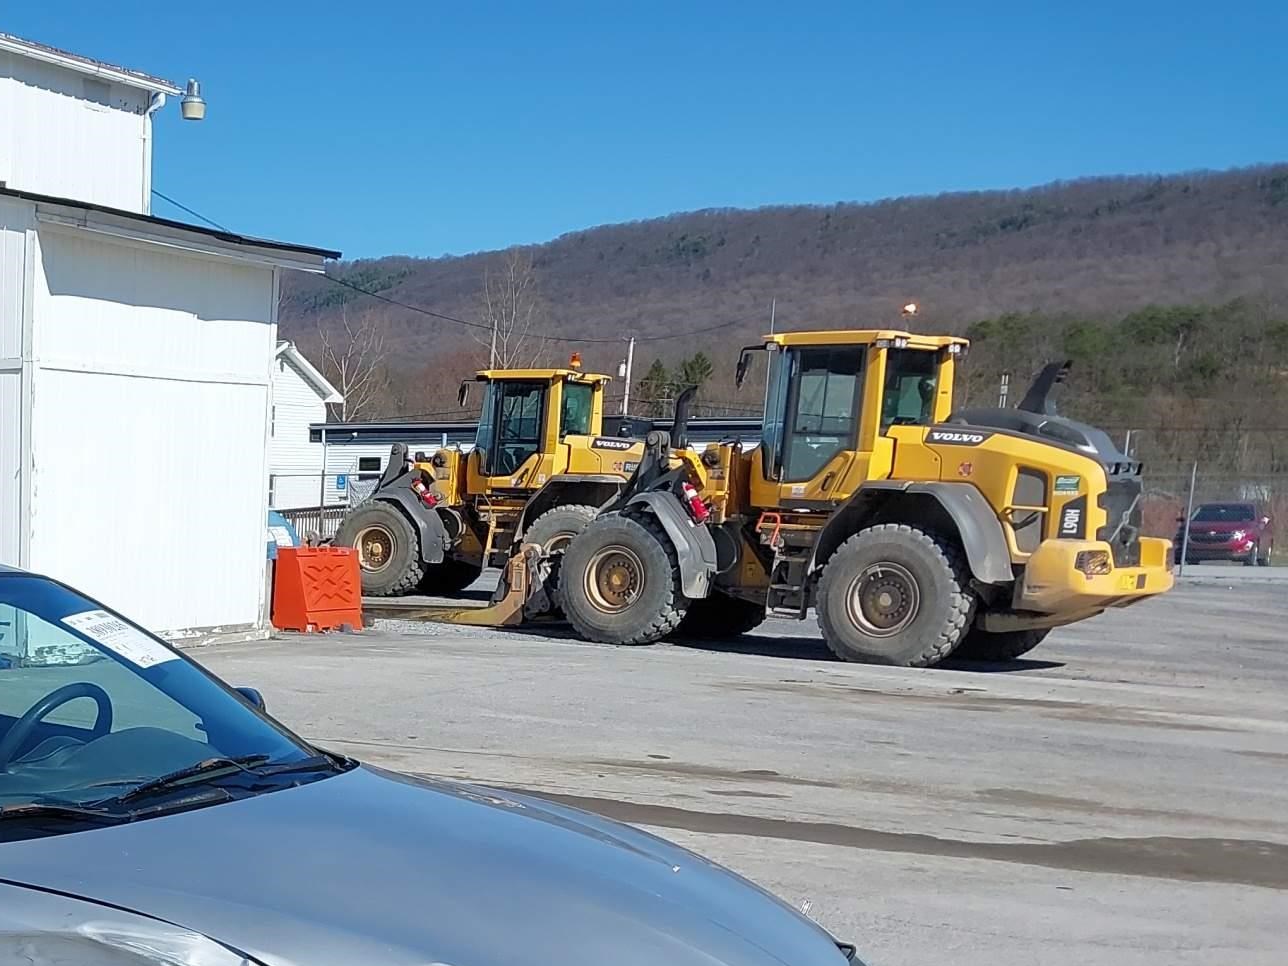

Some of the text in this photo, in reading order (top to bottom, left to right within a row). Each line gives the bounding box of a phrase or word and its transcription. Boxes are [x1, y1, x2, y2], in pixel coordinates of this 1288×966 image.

[932, 431, 984, 443] VOLVO
[595, 440, 630, 449] VOLVO
[1062, 508, 1081, 534] L90H
